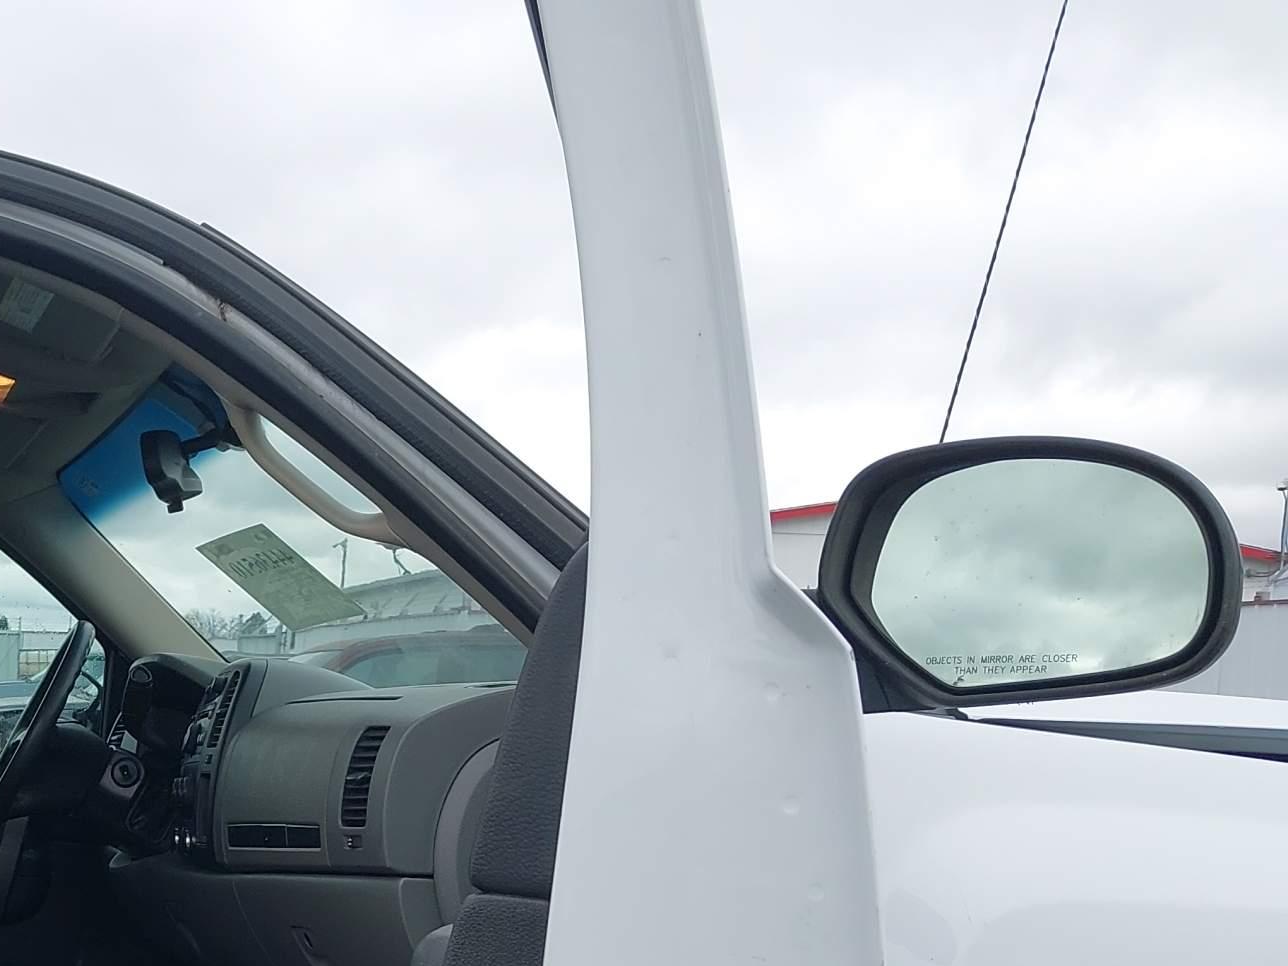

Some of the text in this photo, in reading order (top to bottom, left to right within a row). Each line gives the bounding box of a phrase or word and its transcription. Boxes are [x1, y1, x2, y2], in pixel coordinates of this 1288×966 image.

[925, 653, 1078, 665] OBJECTS IN MIRROR ARE CLOSER
[954, 664, 1048, 675] THAN THEY APPEAR
